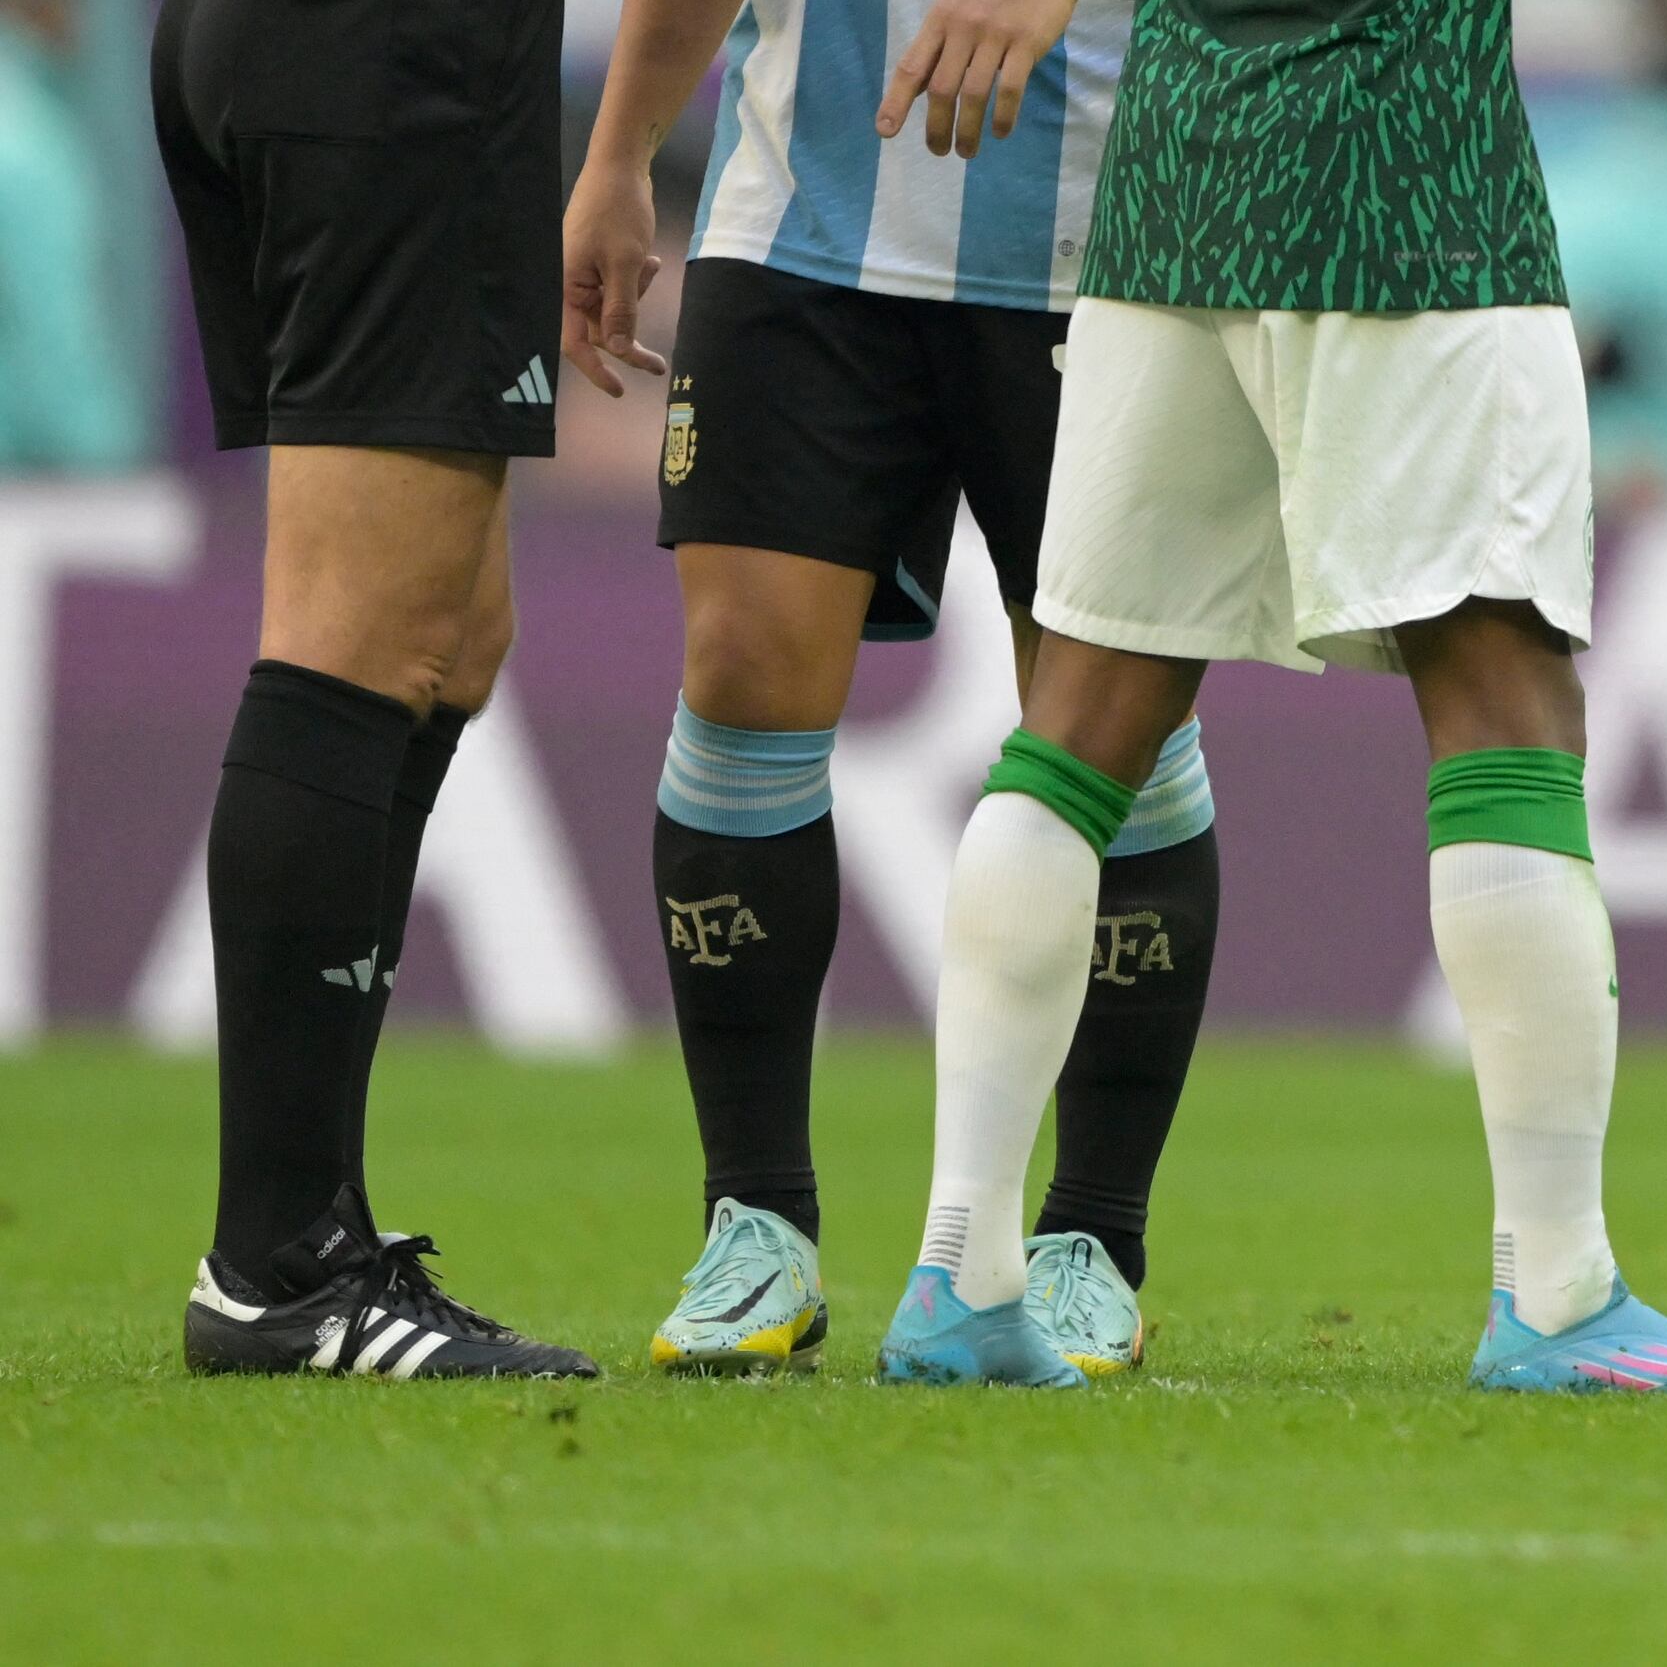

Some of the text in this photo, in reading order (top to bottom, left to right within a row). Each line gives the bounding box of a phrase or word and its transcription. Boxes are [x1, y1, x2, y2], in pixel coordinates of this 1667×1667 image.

[666, 894, 768, 966] AFA
[317, 1224, 346, 1259] adidas
[315, 1315, 338, 1337] COPA
[315, 1317, 349, 1348] MUNDIAL
